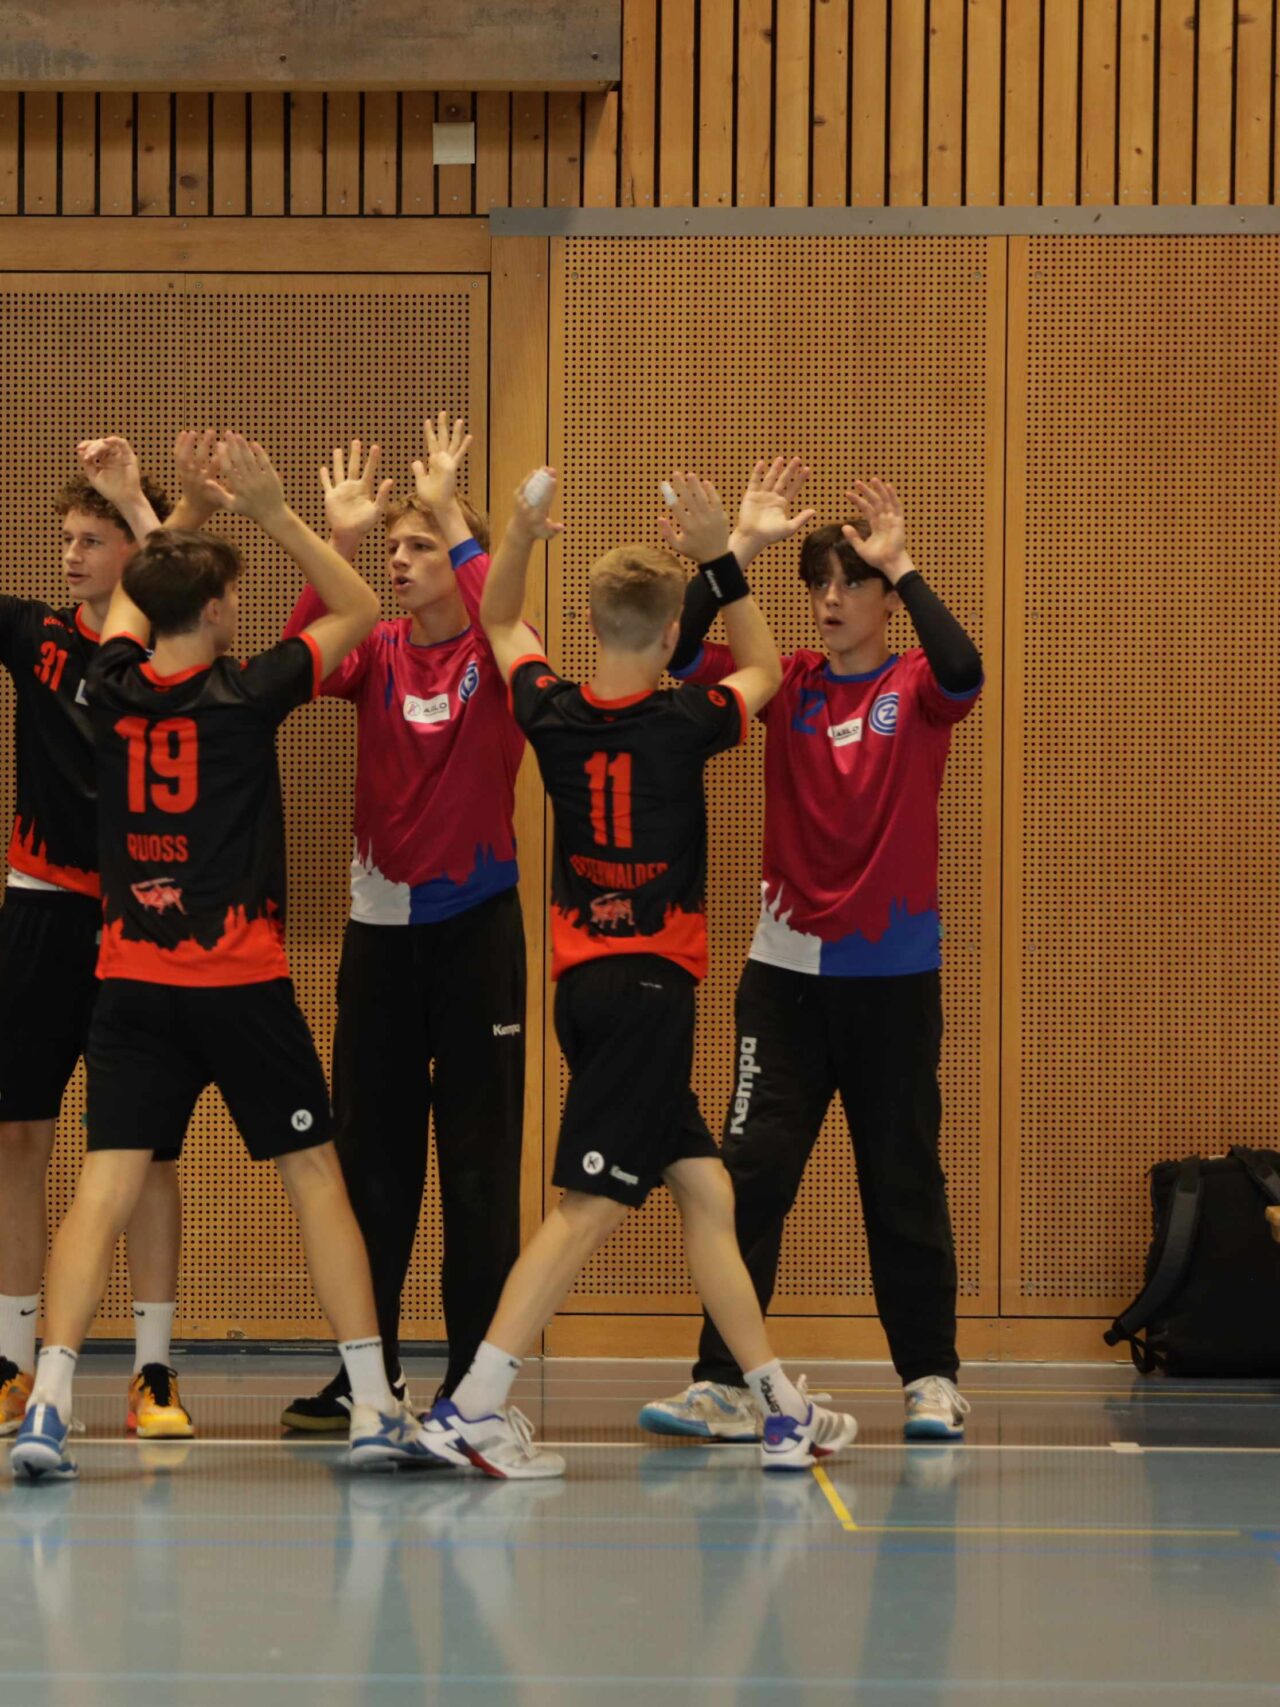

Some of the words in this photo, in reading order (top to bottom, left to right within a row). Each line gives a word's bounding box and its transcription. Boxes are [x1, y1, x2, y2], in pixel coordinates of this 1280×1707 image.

[33, 640, 69, 693] 31
[113, 715, 199, 814] 19
[583, 751, 633, 849] 11
[729, 1035, 762, 1135] Kempa
